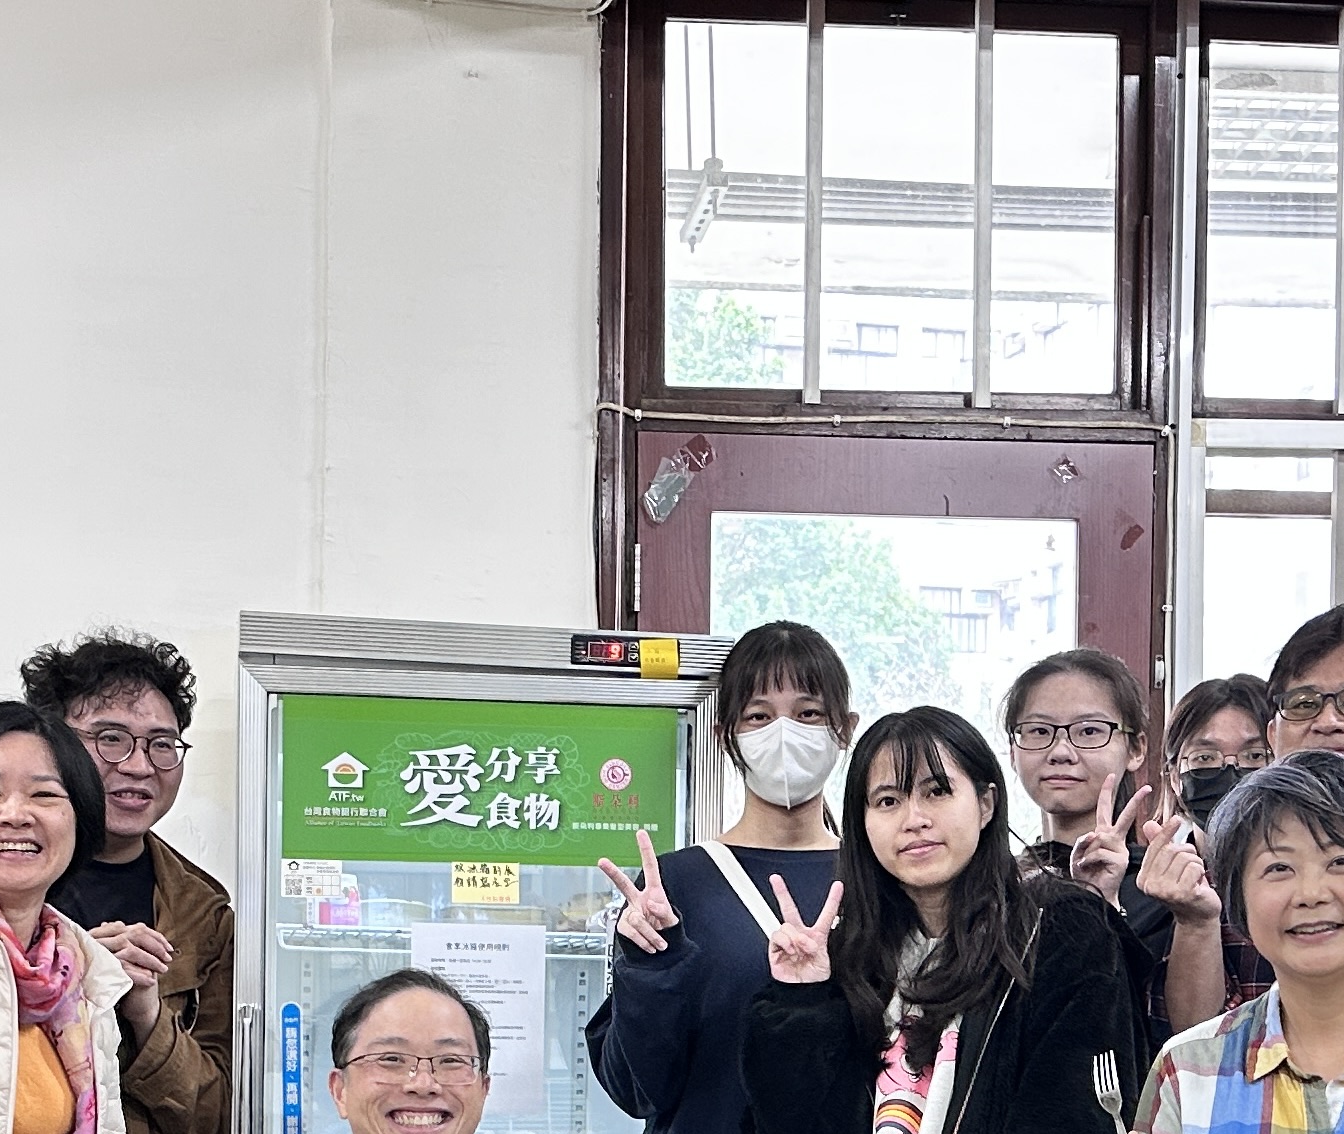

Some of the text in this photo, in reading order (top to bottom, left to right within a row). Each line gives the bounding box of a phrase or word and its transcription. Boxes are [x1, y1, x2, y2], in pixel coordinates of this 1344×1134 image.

[485, 746, 561, 784] 分享
[400, 744, 485, 828] 愛
[485, 792, 561, 831] 食物
